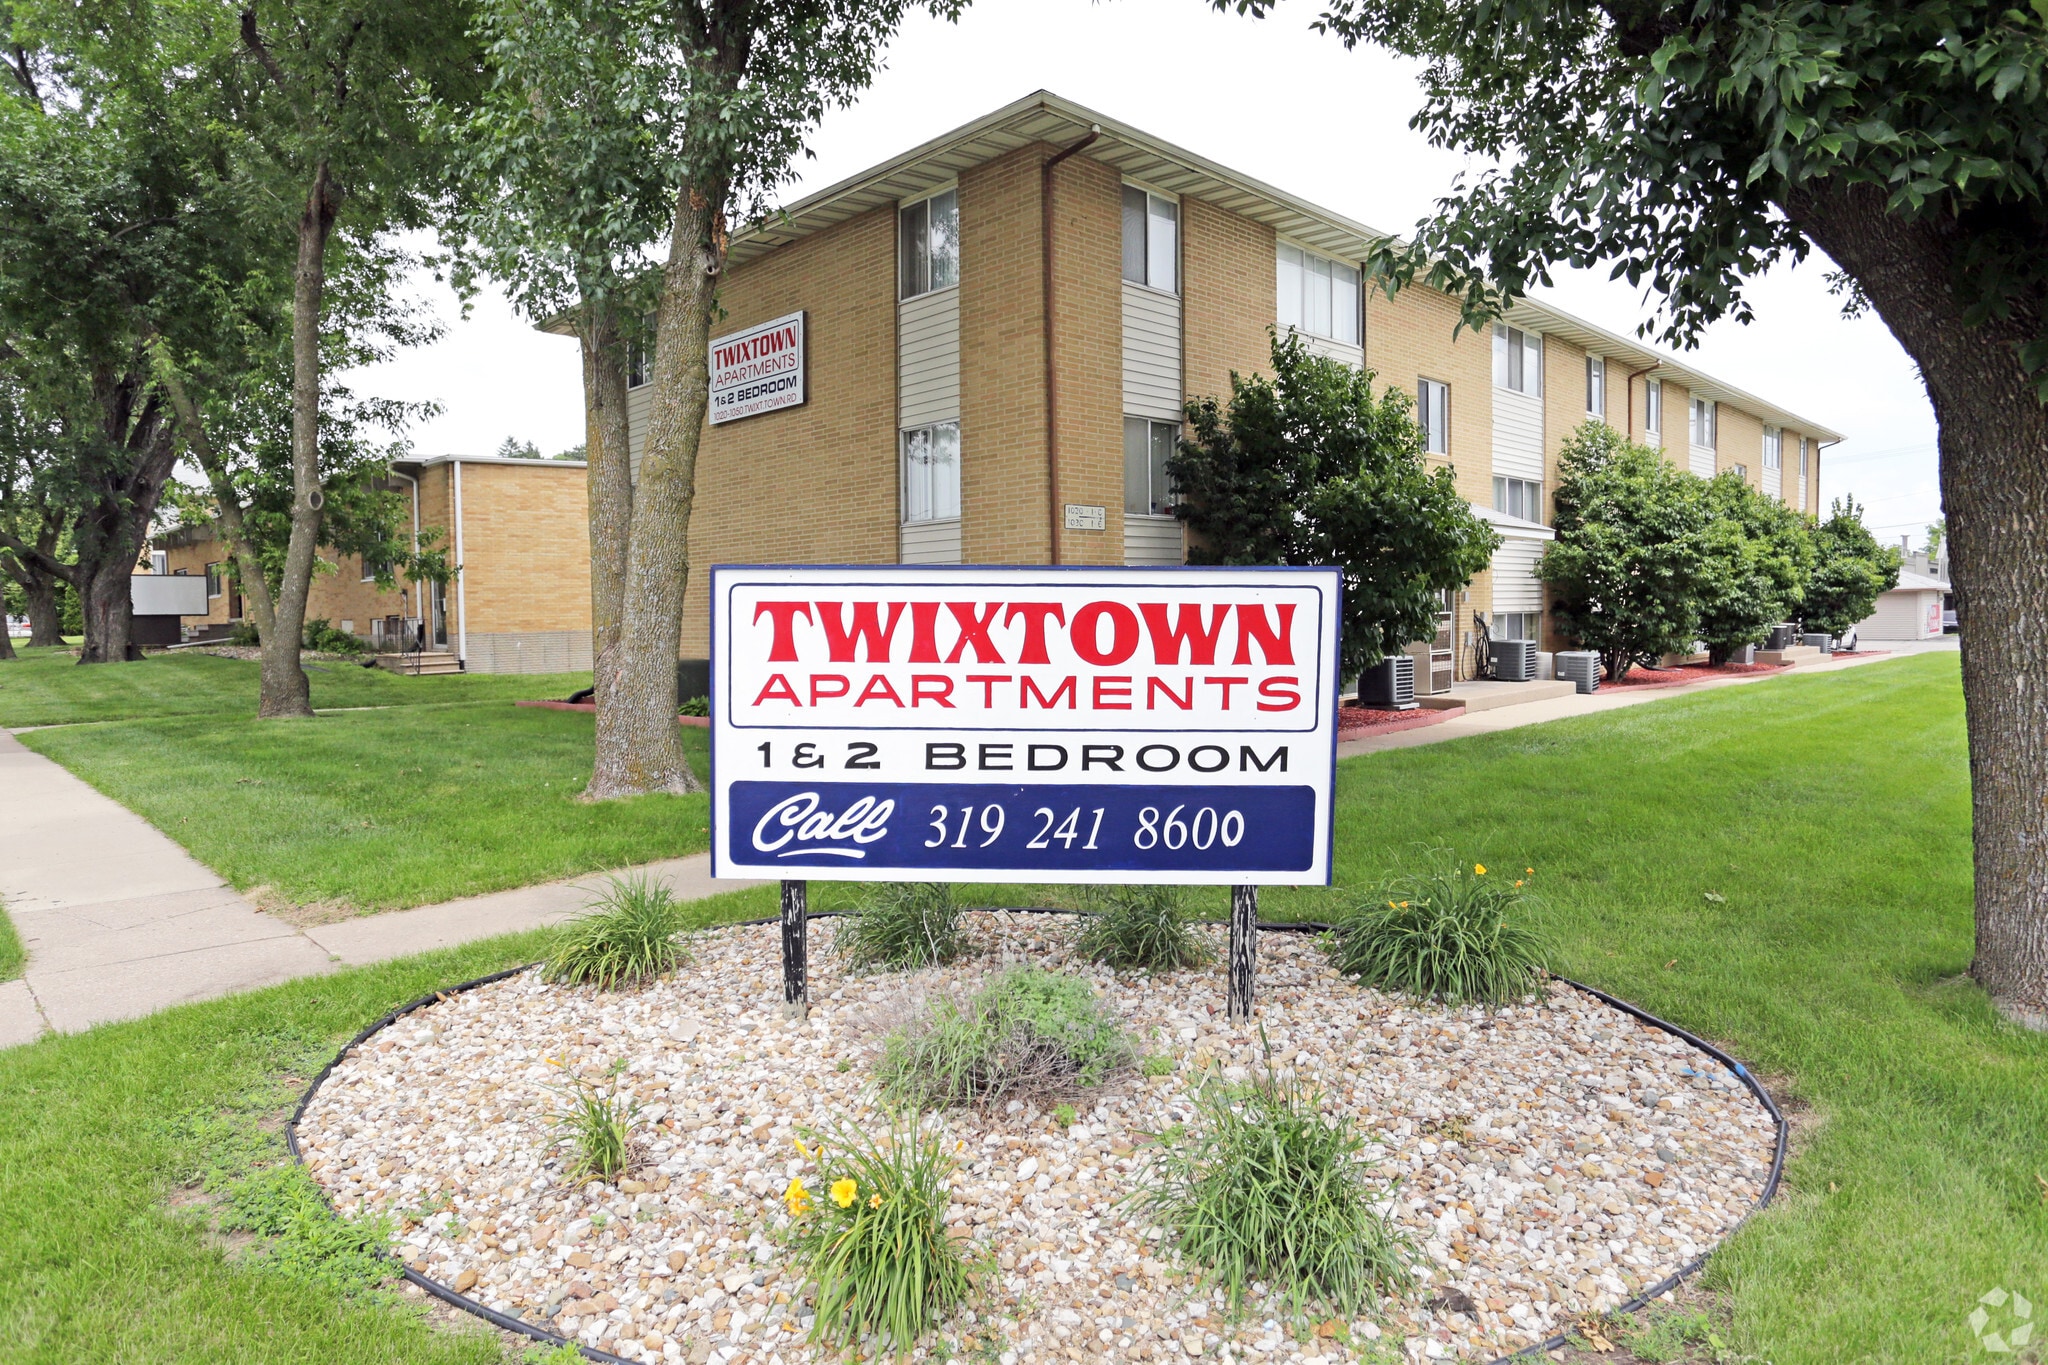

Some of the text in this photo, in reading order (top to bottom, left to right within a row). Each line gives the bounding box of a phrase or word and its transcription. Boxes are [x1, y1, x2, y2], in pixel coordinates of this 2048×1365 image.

[714, 325, 796, 371] TWIXTOWN
[715, 352, 796, 388] APARTMENTS
[737, 375, 797, 402] BEDROOM
[752, 600, 1298, 667] TWIXTOWN
[751, 673, 1302, 712] APARTMENTS
[925, 742, 1289, 773] BEDROOM
[752, 792, 1245, 852] Call 319 241 8600
